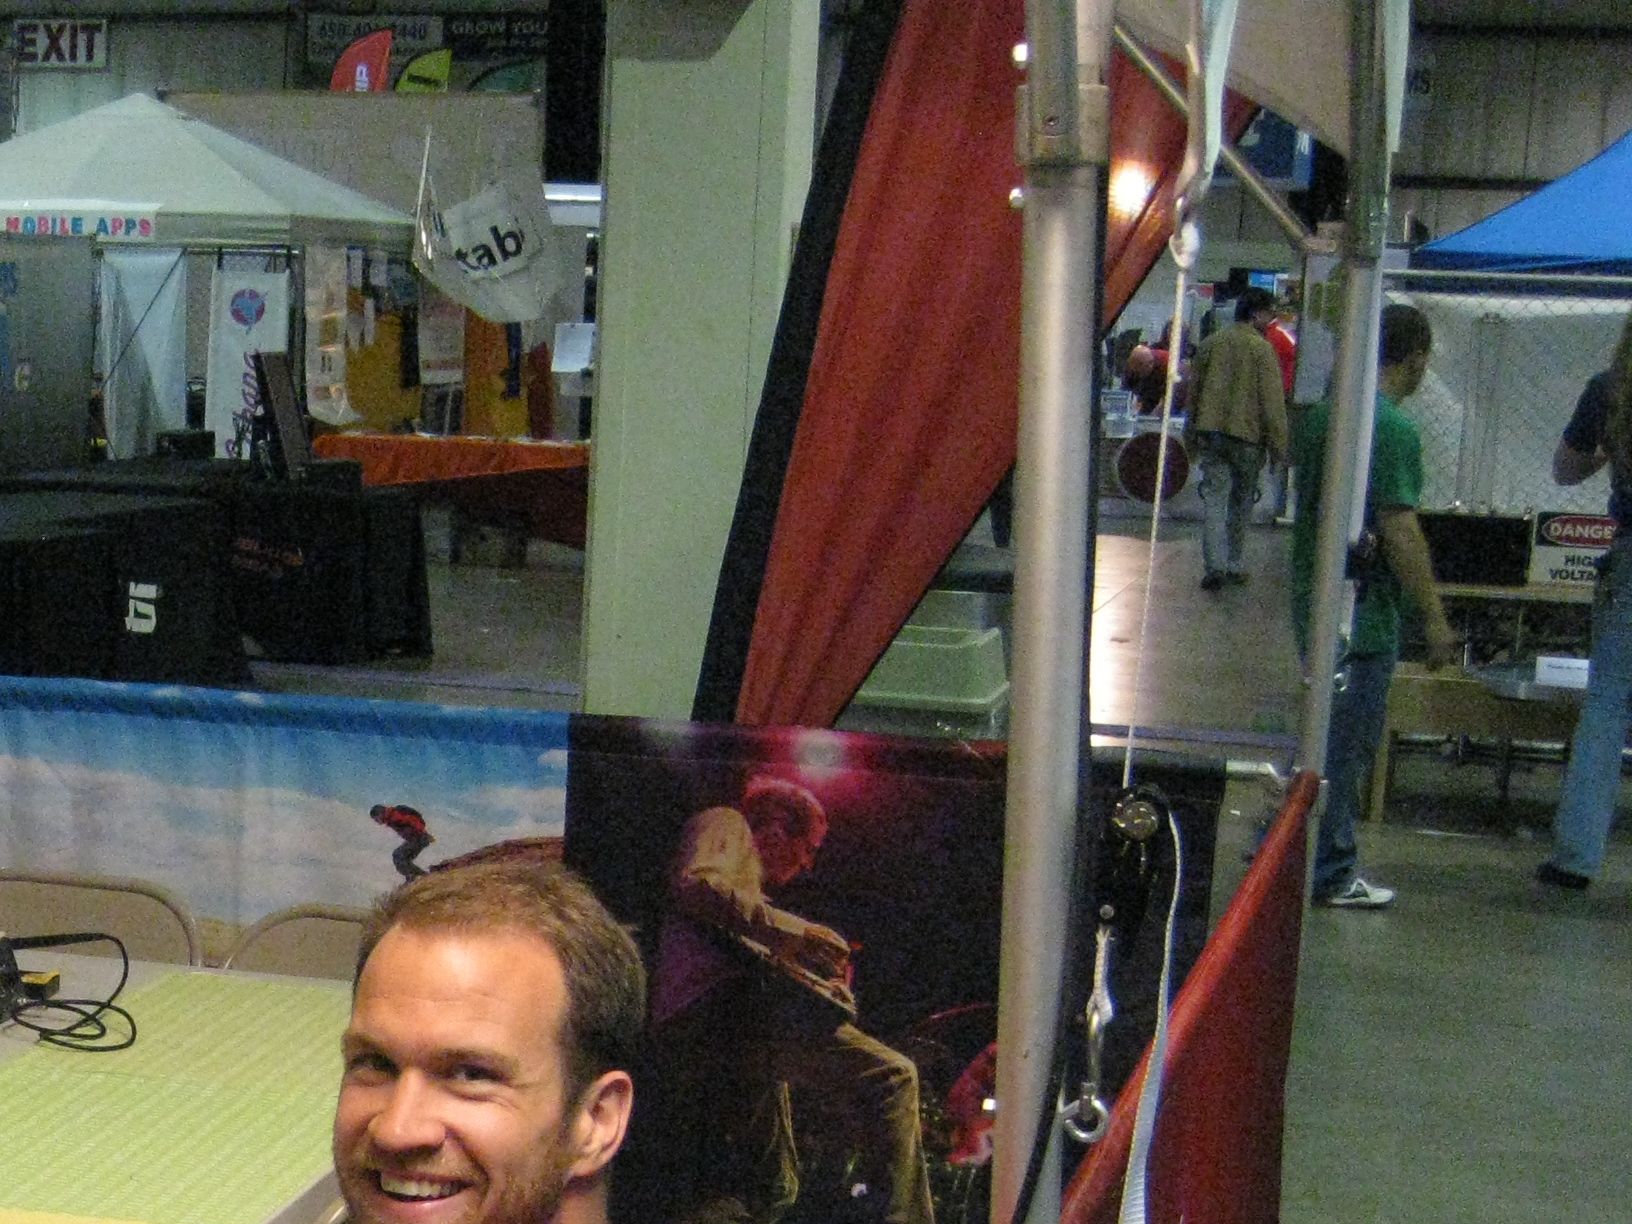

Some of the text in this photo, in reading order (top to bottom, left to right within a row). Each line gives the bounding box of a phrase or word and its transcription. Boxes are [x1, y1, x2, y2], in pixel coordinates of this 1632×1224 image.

[512, 20, 549, 35] YOU
[17, 23, 102, 62] EXIT
[5, 216, 83, 237] MOBILE
[95, 217, 153, 238] APPS
[1549, 522, 1617, 539] DANGE
[1564, 554, 1594, 568] HIG
[1549, 568, 1596, 581] VOLTA
